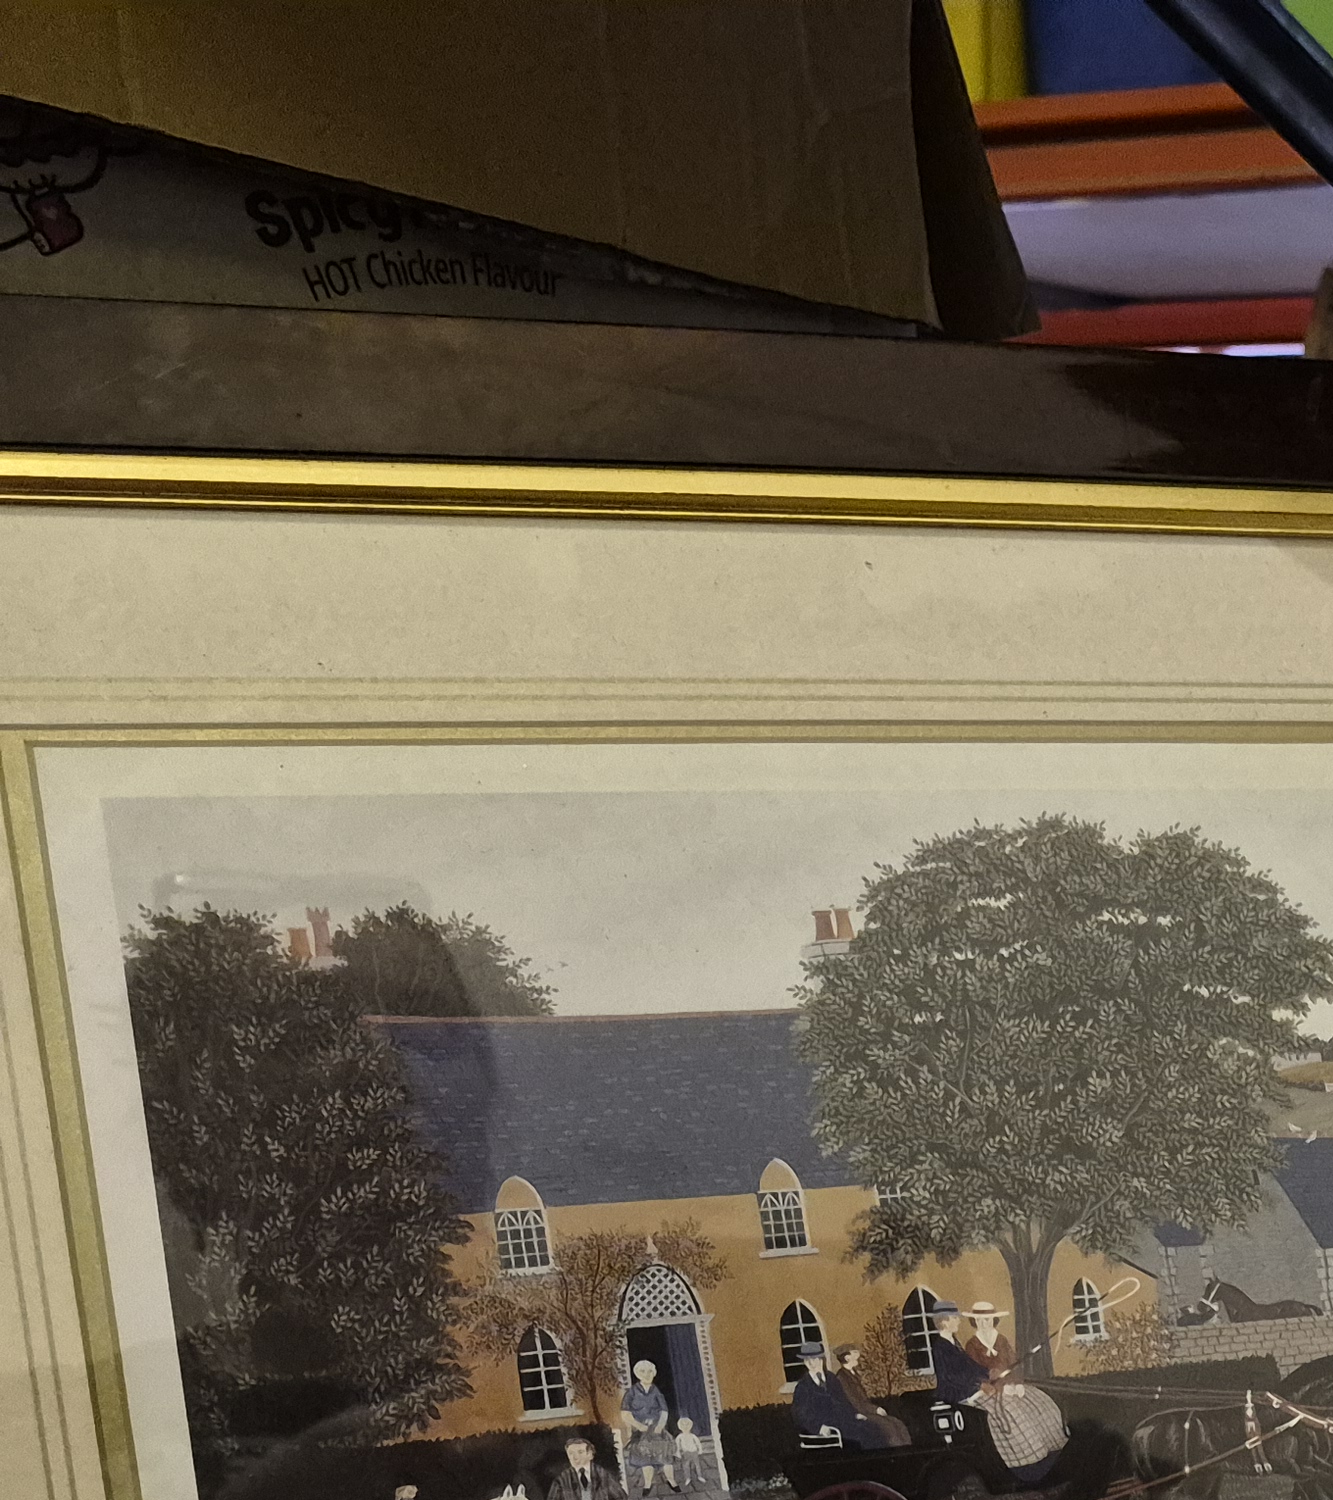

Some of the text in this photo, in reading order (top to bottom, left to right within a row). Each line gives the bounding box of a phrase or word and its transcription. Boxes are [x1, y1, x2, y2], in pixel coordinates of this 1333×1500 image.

[245, 187, 402, 254] Spicy
[302, 249, 565, 302] HOT Chicken Flavour
